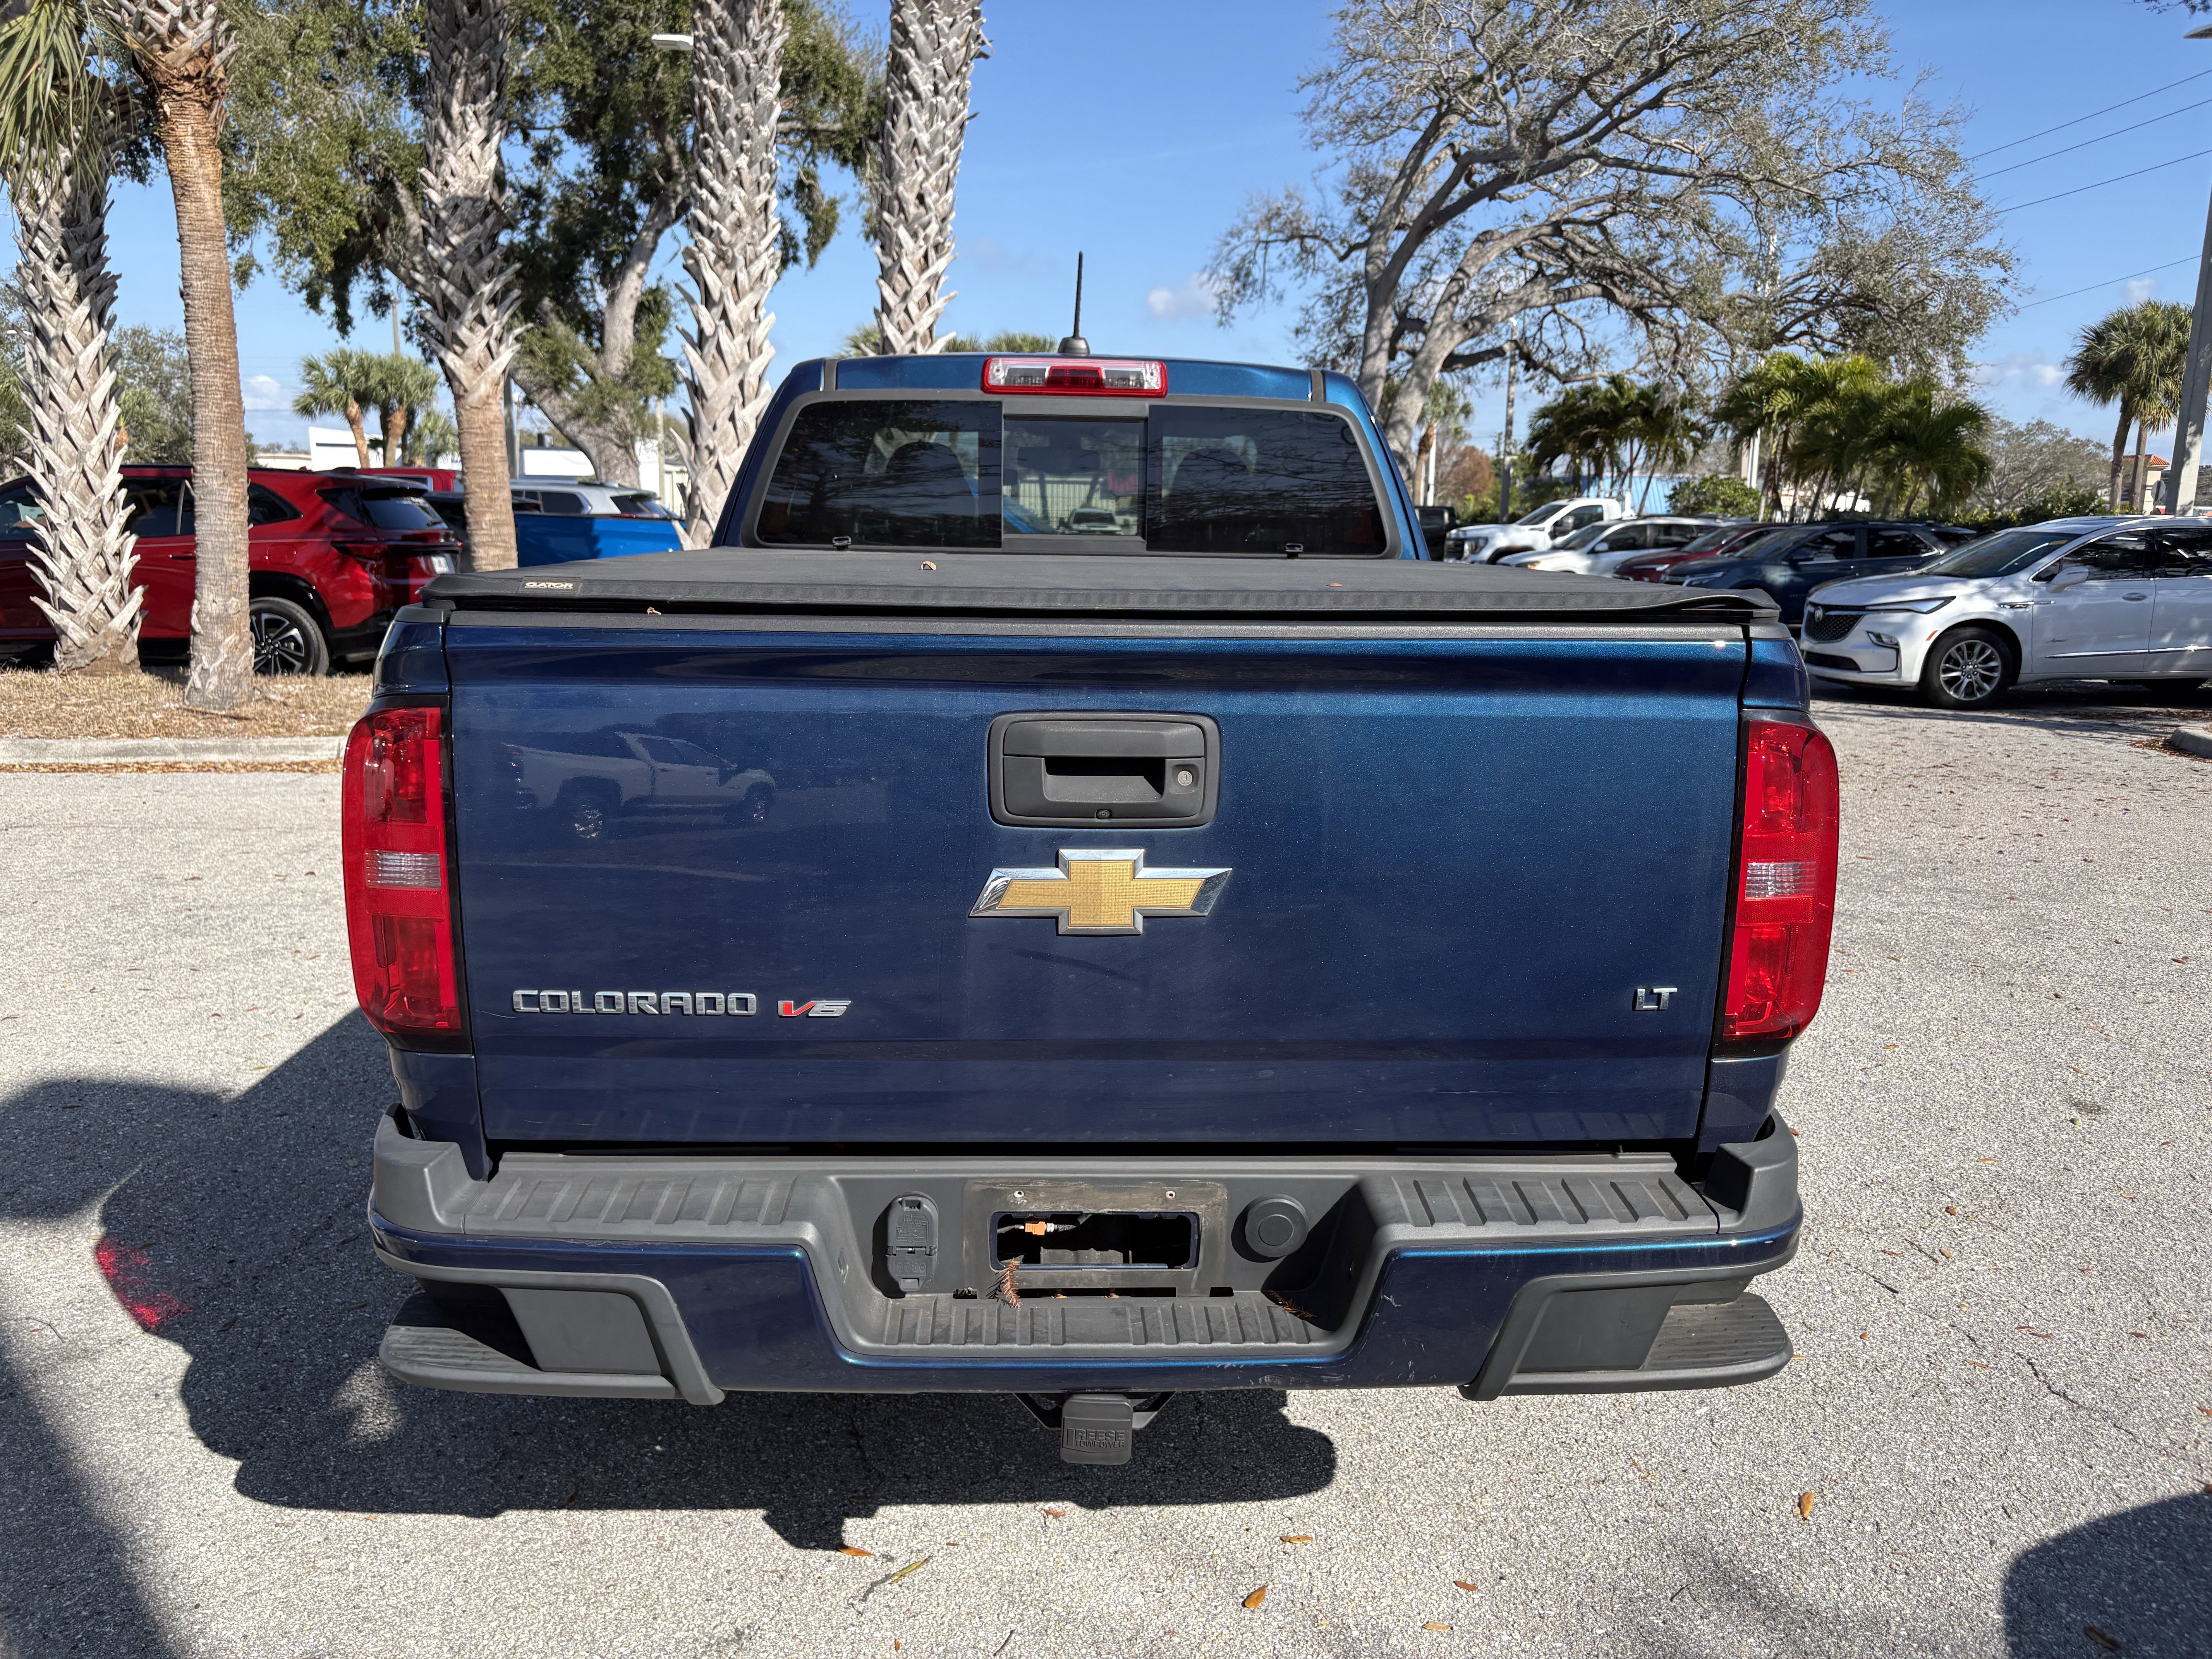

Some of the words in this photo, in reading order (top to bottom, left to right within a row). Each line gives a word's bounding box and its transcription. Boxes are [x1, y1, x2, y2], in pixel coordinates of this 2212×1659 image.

[513, 990, 757, 1015] COLORADO
[778, 1000, 851, 1016] V6
[1635, 988, 1678, 1010] LT
[1074, 1429, 1125, 1440] REESE
[1075, 1440, 1125, 1448] TOWPOWER
